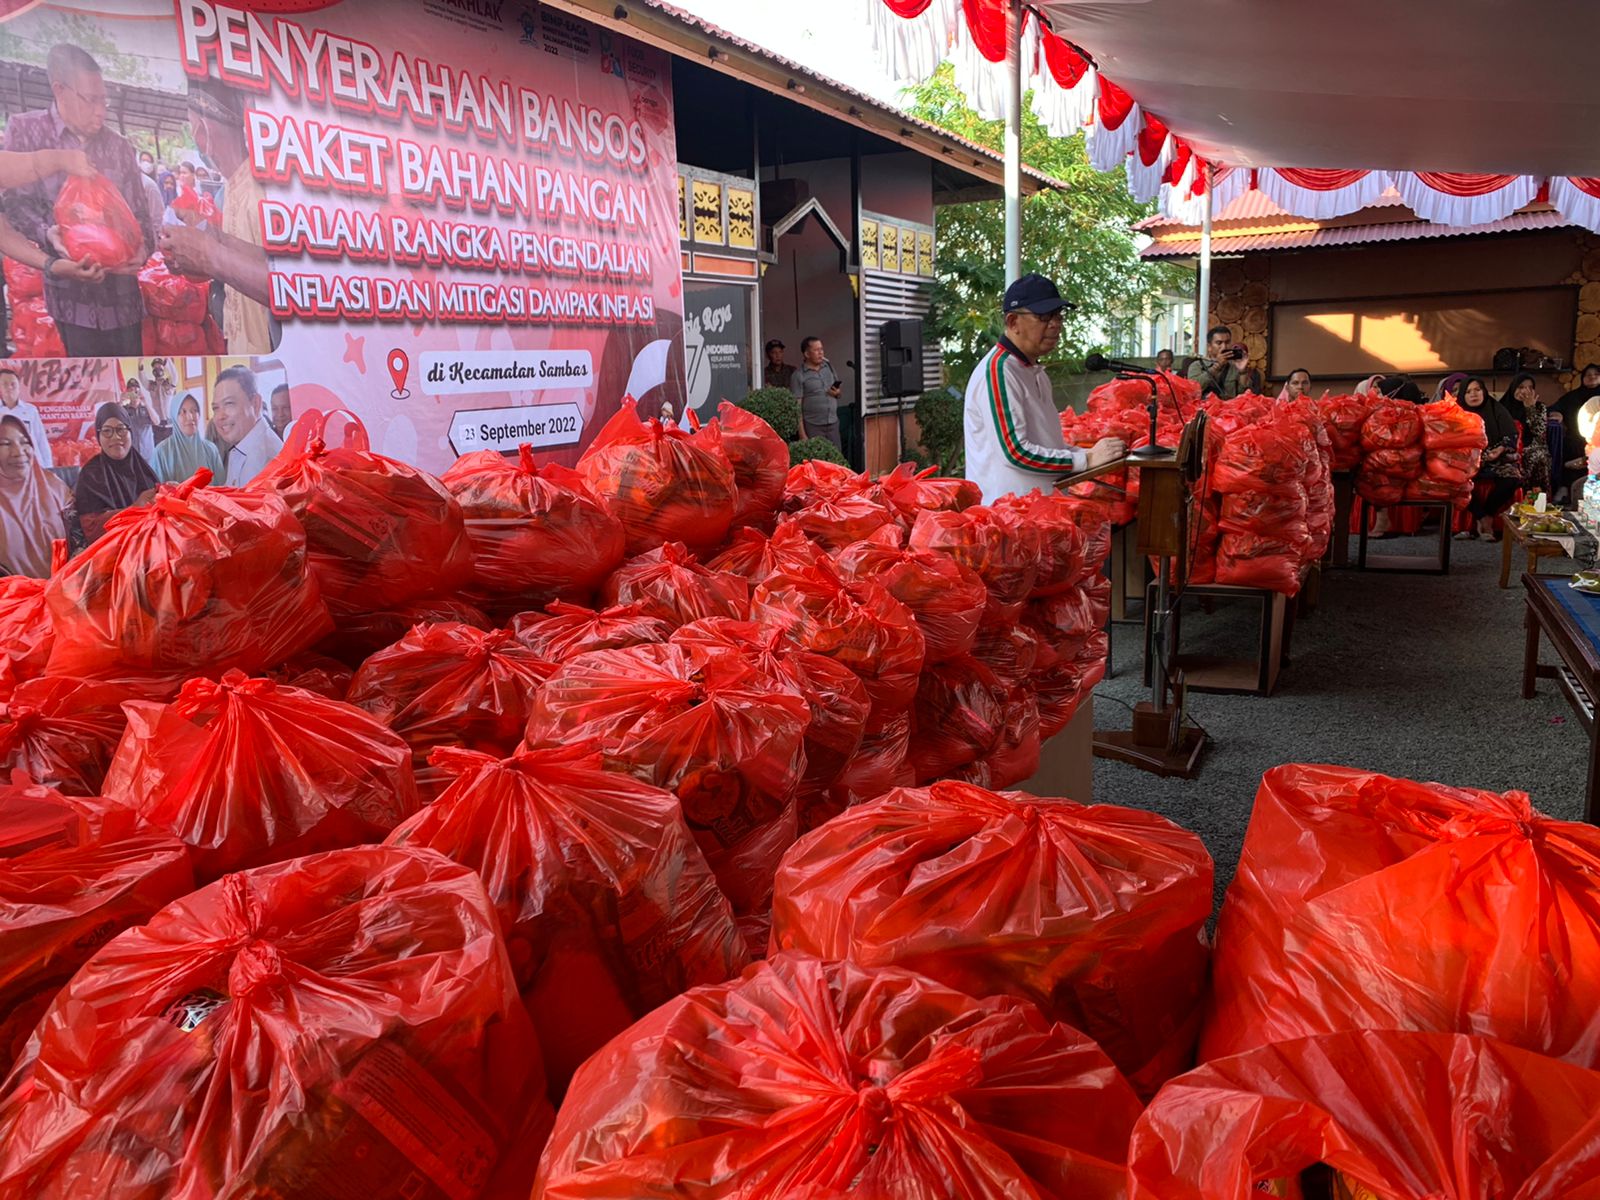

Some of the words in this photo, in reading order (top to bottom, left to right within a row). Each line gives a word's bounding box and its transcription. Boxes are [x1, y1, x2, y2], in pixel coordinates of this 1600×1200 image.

[179, 0, 511, 134] PENYERAHAN
[522, 90, 646, 164] BANSOS
[248, 112, 388, 187] PAKET
[400, 142, 524, 205] BAHAN
[537, 169, 648, 226] PANGAN
[263, 202, 385, 252] DALAM
[394, 218, 502, 262] RANGKA
[511, 231, 650, 276] PENGENDALIAN
[271, 274, 369, 310] INFLASI
[378, 285, 432, 313] DAN
[439, 288, 524, 316] MITIGASI
[529, 292, 599, 318] DAMPAK
[603, 296, 653, 319] INFLASI
[702, 304, 732, 333] Raya
[427, 362, 445, 383] di
[448, 361, 536, 384] Kecamatan
[539, 359, 588, 378] Sambas
[464, 428, 476, 441] 23
[480, 418, 546, 443] September
[548, 416, 576, 435] 2022
